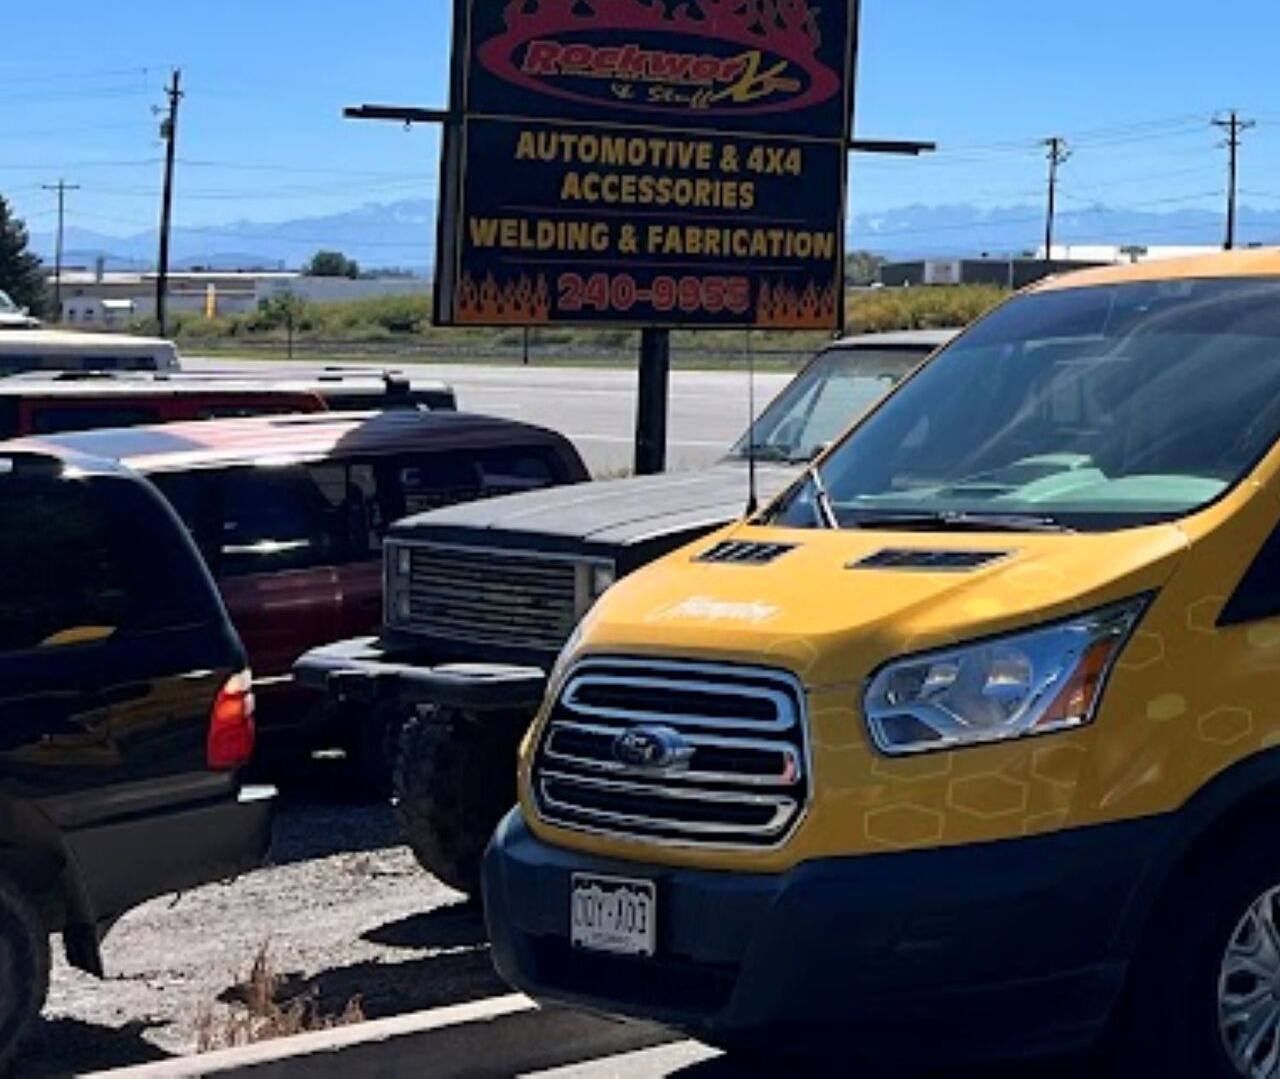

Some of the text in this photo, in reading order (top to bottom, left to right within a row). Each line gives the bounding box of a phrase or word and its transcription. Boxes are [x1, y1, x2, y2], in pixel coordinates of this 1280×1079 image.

[514, 131, 802, 176] AUTOMOTIVE & 4X4
[560, 171, 755, 209] ACCESSORIES
[470, 217, 835, 260] WELDING & FABRICATION
[556, 272, 752, 313] 240-9955
